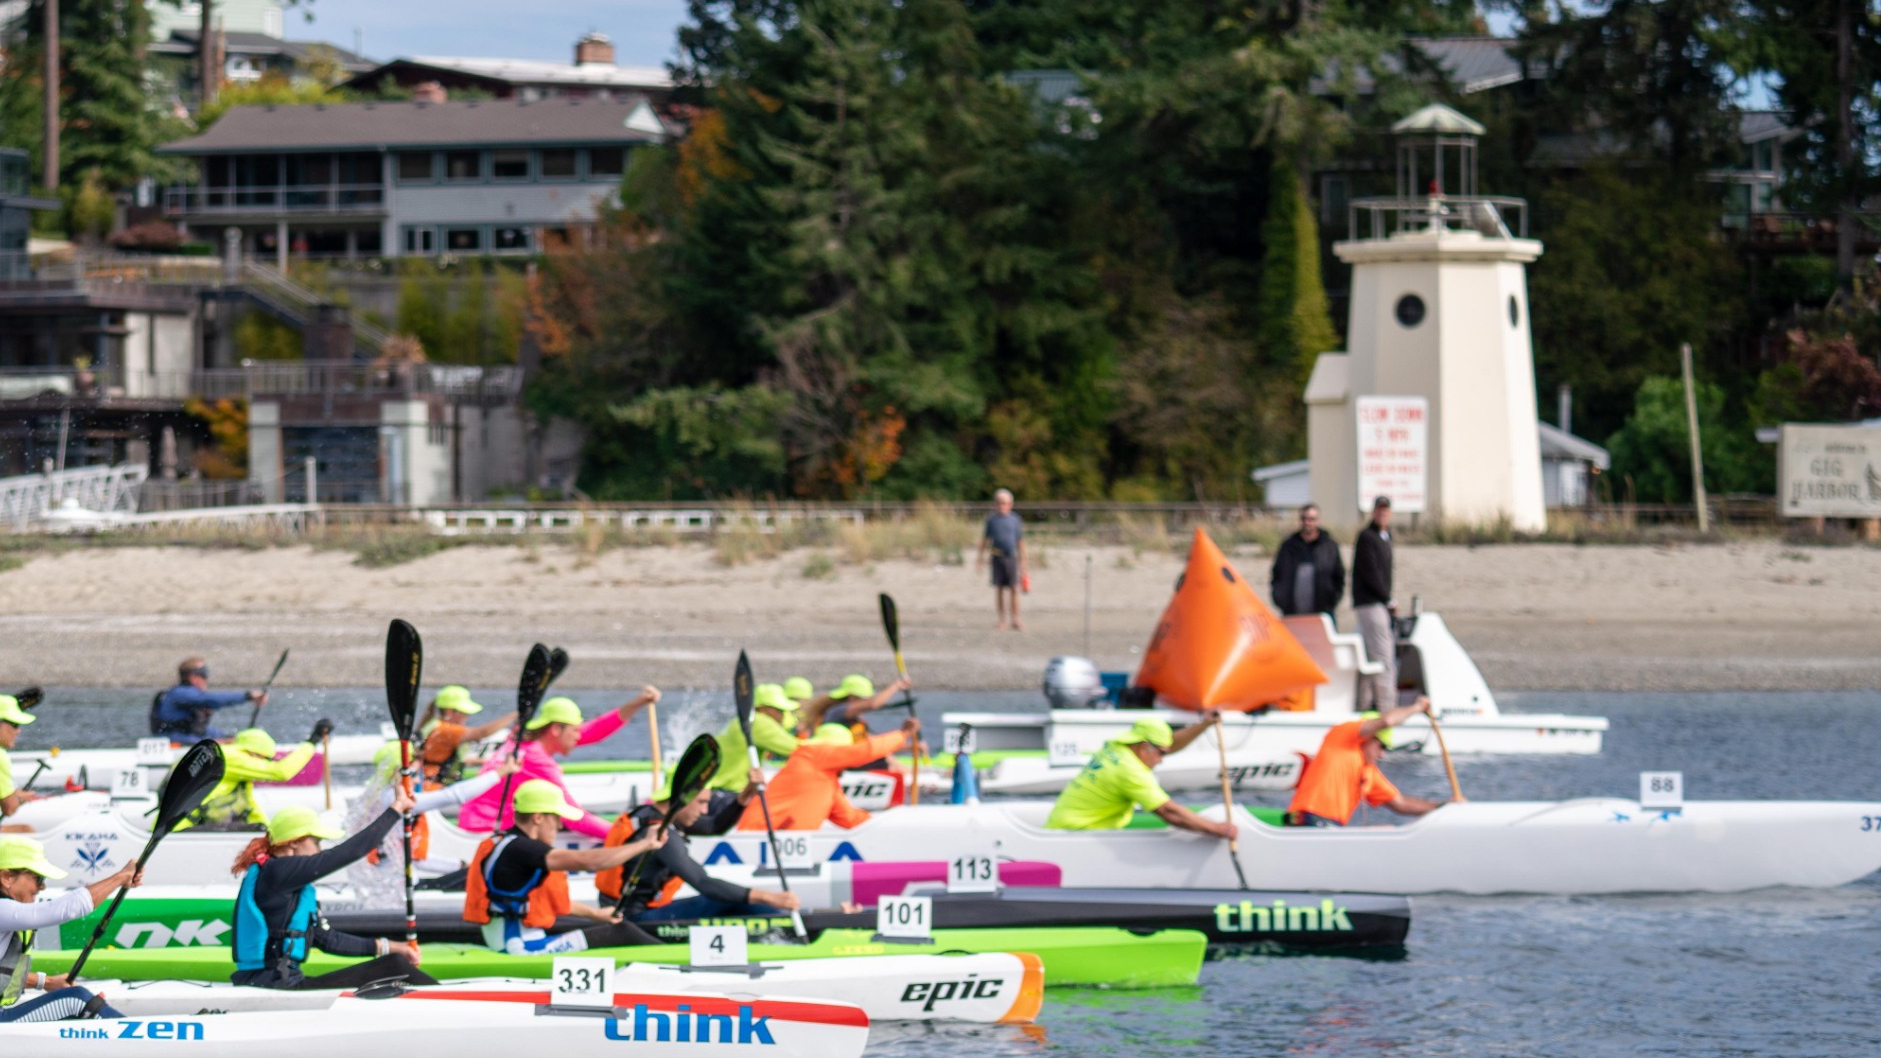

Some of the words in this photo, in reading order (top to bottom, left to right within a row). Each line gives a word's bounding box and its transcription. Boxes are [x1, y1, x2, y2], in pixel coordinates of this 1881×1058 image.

[1810, 458, 1844, 477] GIG
[1792, 481, 1859, 499] HARBOR
[120, 771, 139, 787] 78
[1650, 777, 1675, 793] 88
[954, 857, 992, 880] 113
[885, 902, 923, 924] 101
[1213, 899, 1354, 932] think
[709, 934, 725, 954] 4
[558, 968, 606, 993] 331
[900, 974, 1004, 1012] epic
[59, 1027, 109, 1039] think
[604, 1003, 776, 1046] think
